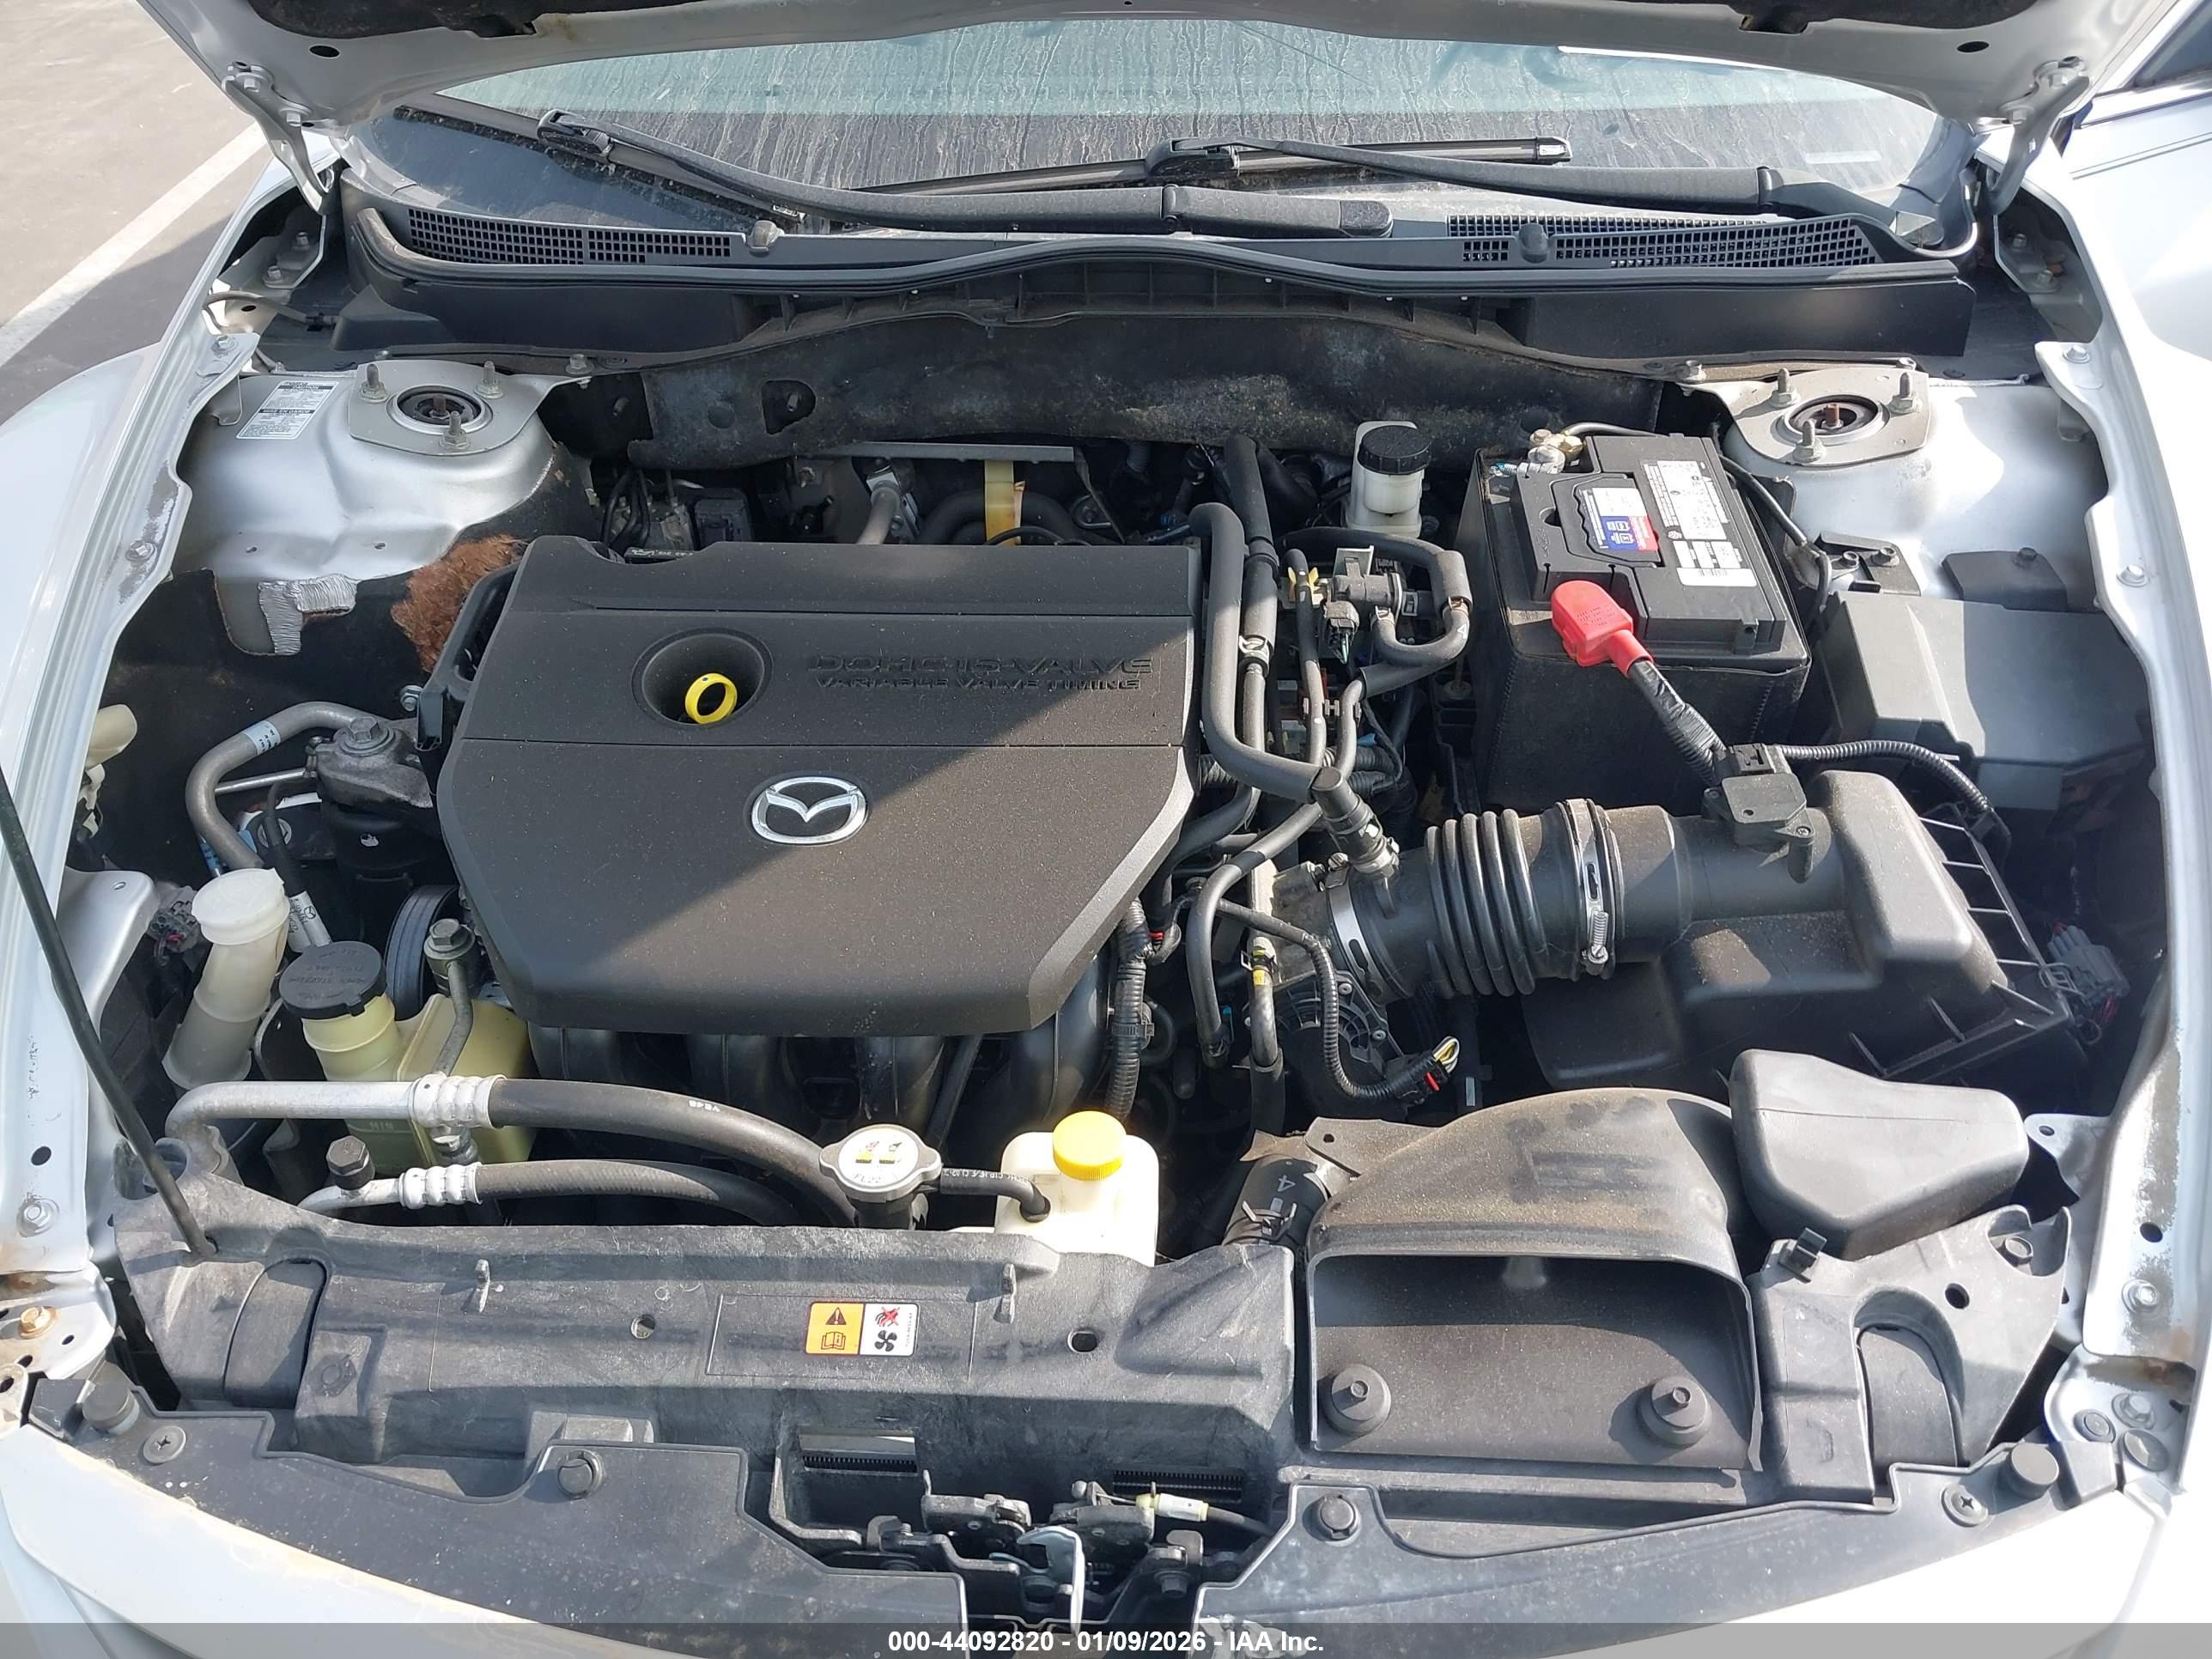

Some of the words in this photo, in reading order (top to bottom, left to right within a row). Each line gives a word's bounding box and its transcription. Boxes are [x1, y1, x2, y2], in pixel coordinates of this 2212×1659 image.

[957, 678, 1039, 690] VALVE
[1047, 678, 1142, 691] TIMING
[1277, 1174, 1297, 1193] 4
